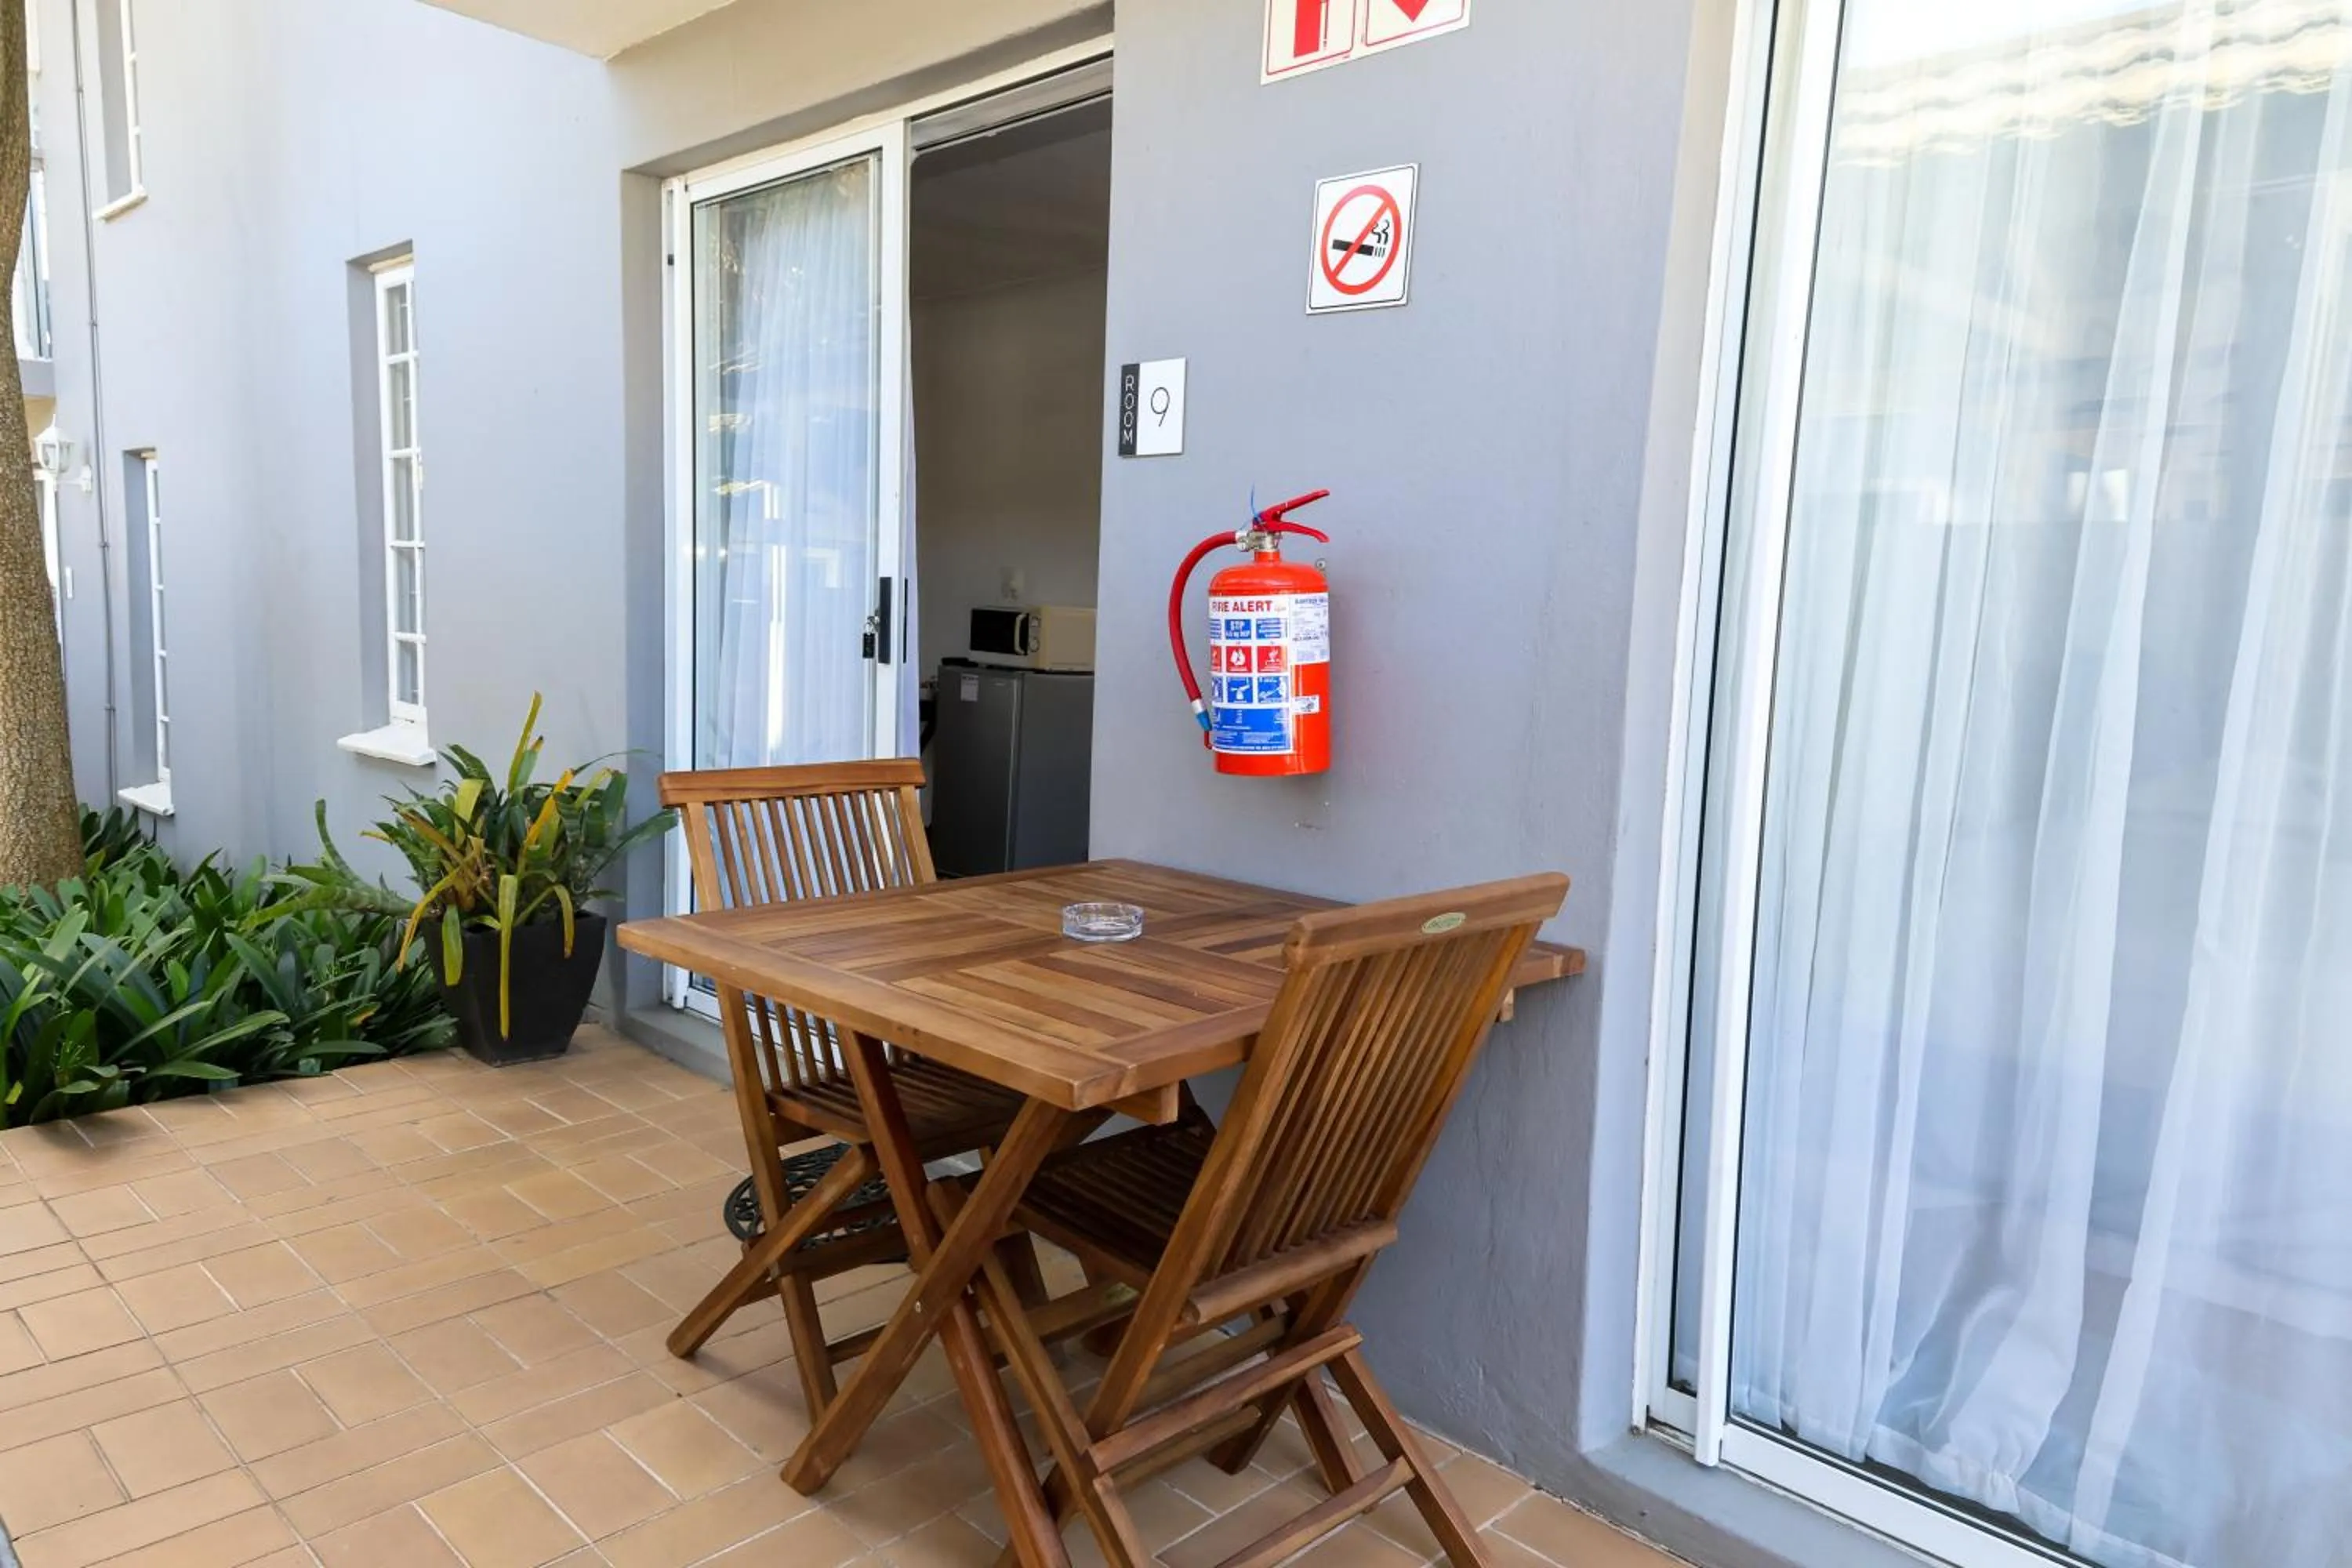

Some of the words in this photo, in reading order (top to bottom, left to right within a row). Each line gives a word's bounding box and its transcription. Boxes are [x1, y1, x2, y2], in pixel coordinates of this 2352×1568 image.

[1123, 374, 1134, 445] ROOM
[1150, 387, 1171, 427] 9
[1232, 601, 1272, 612] ALERT
